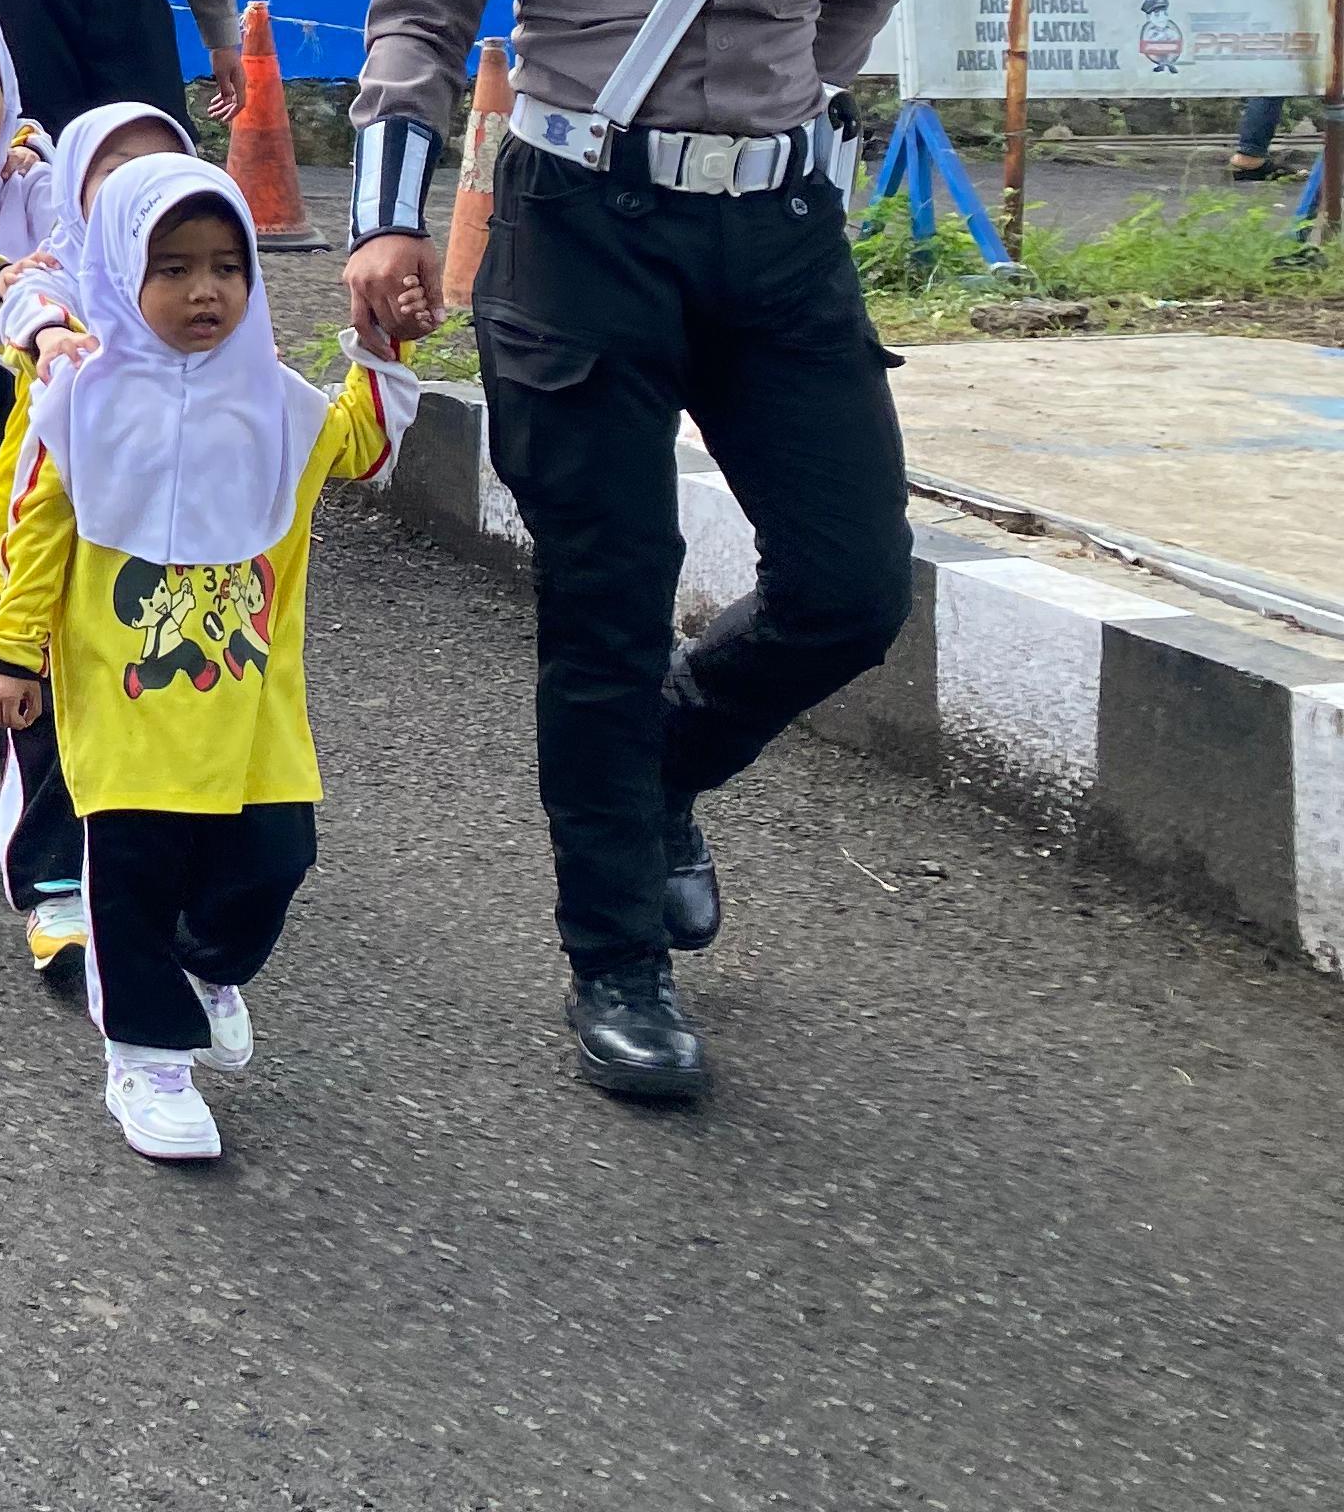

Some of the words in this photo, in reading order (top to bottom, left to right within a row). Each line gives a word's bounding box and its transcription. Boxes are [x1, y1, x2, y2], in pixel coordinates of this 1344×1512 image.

[957, 49, 997, 71] AREA
[1078, 49, 1120, 70] ANAK
[203, 566, 217, 593] 3
